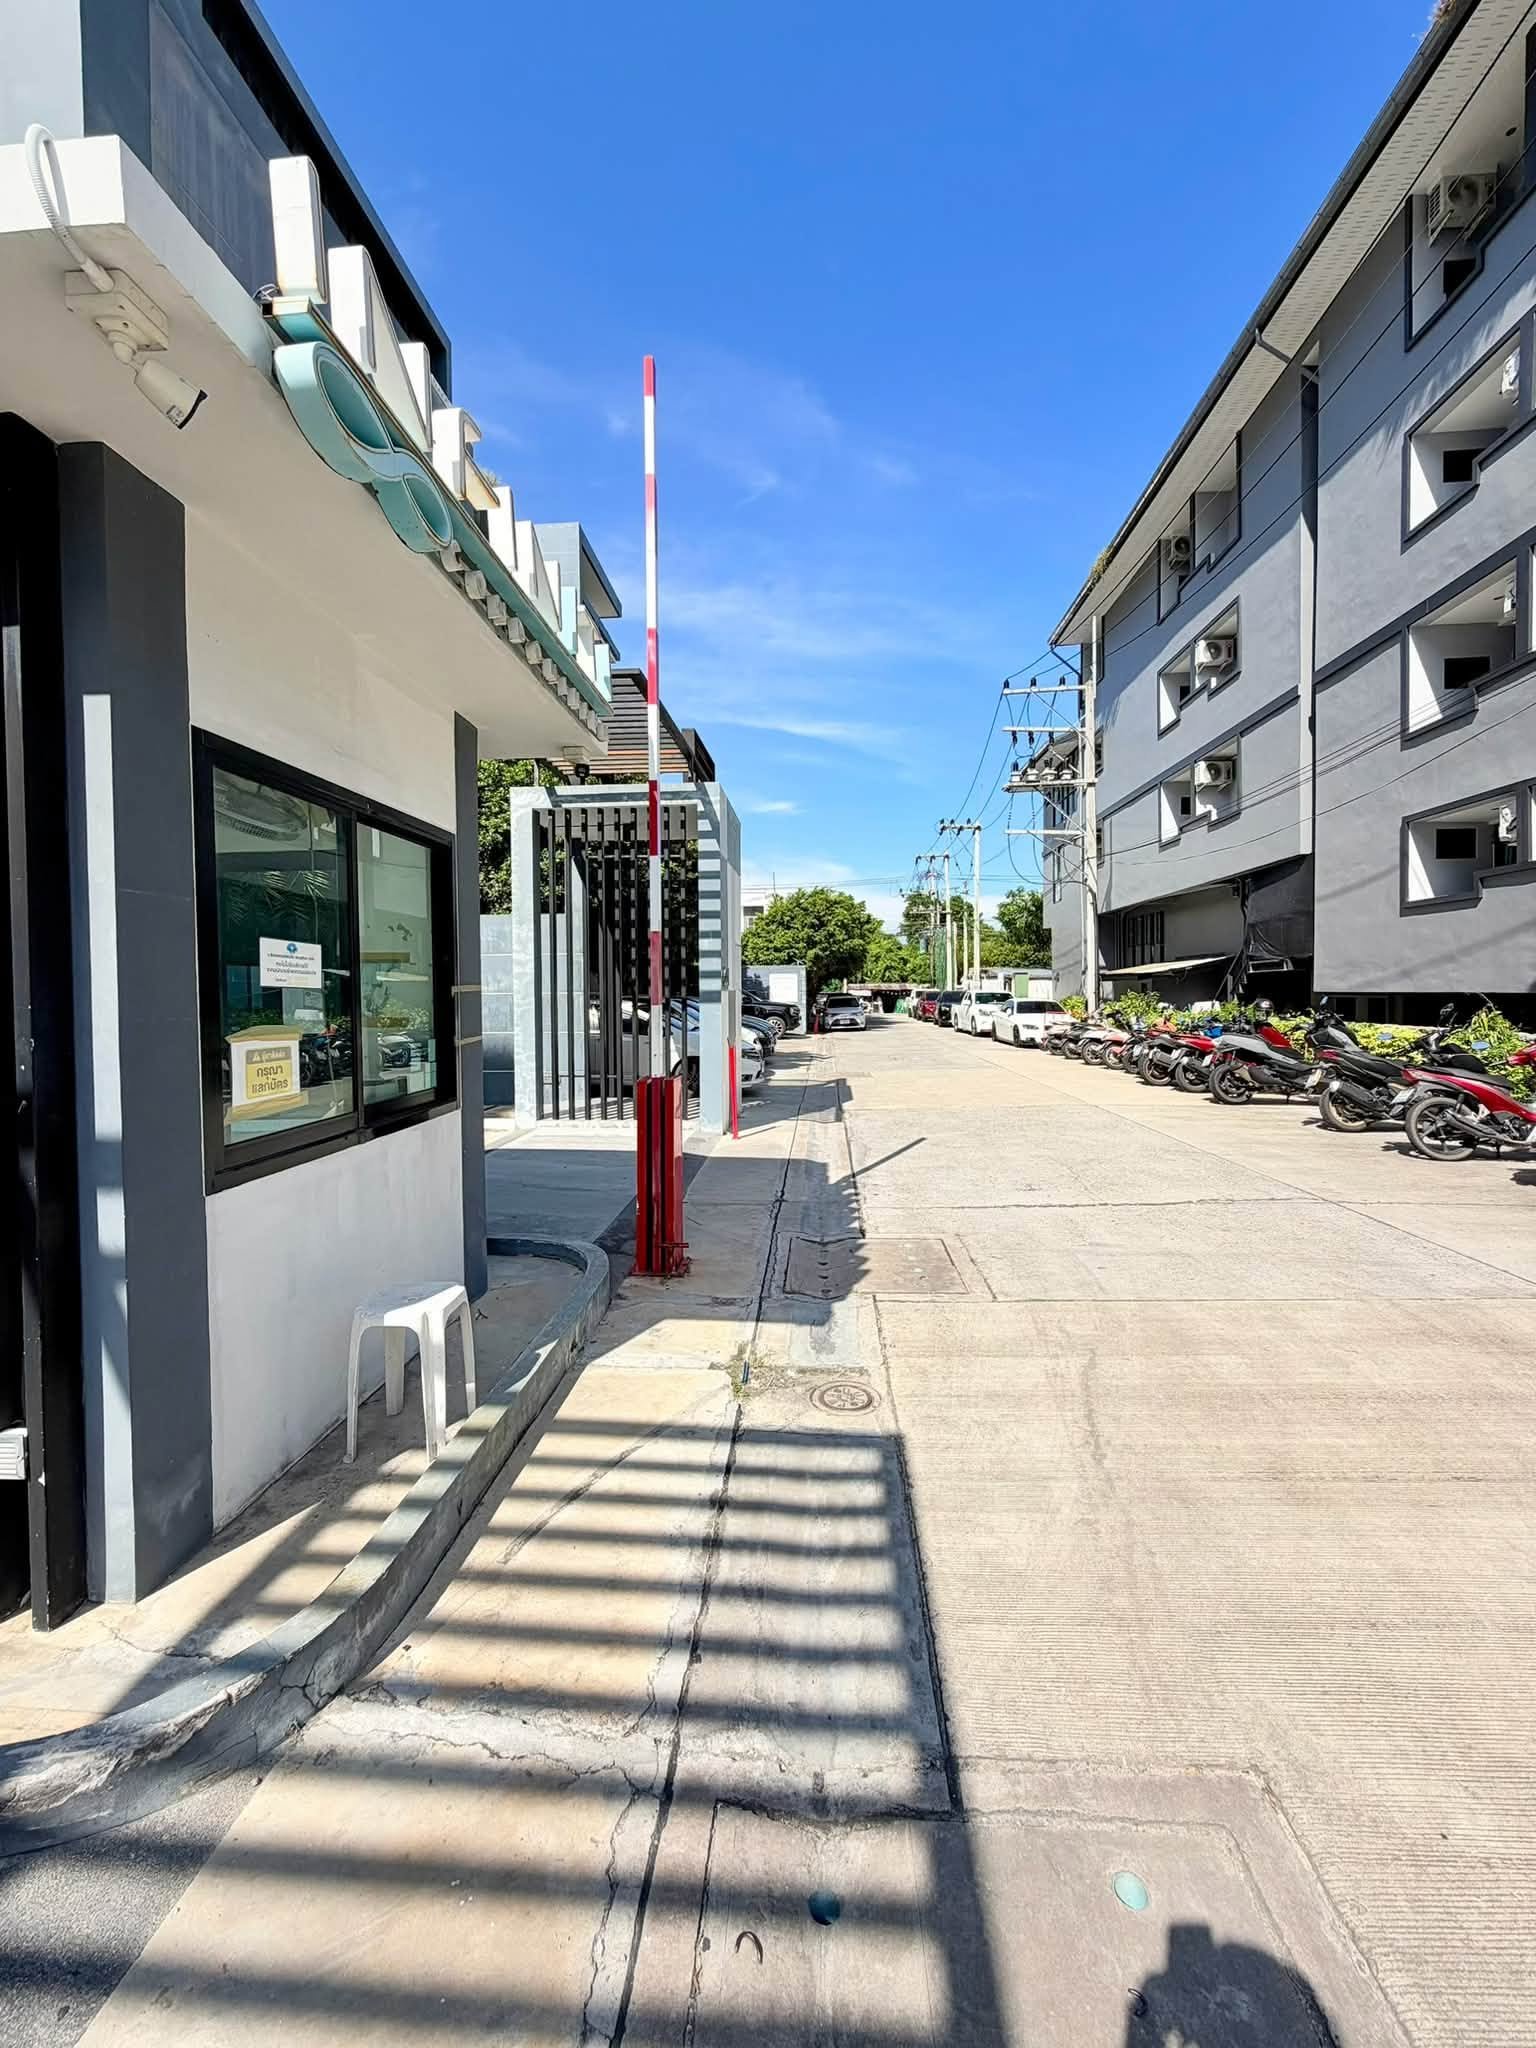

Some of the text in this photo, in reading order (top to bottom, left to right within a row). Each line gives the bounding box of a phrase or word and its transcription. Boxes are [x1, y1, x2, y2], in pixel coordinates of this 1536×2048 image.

[256, 1065, 284, 1081] กรุณา
[251, 1077, 289, 1094] แลกบัตร
